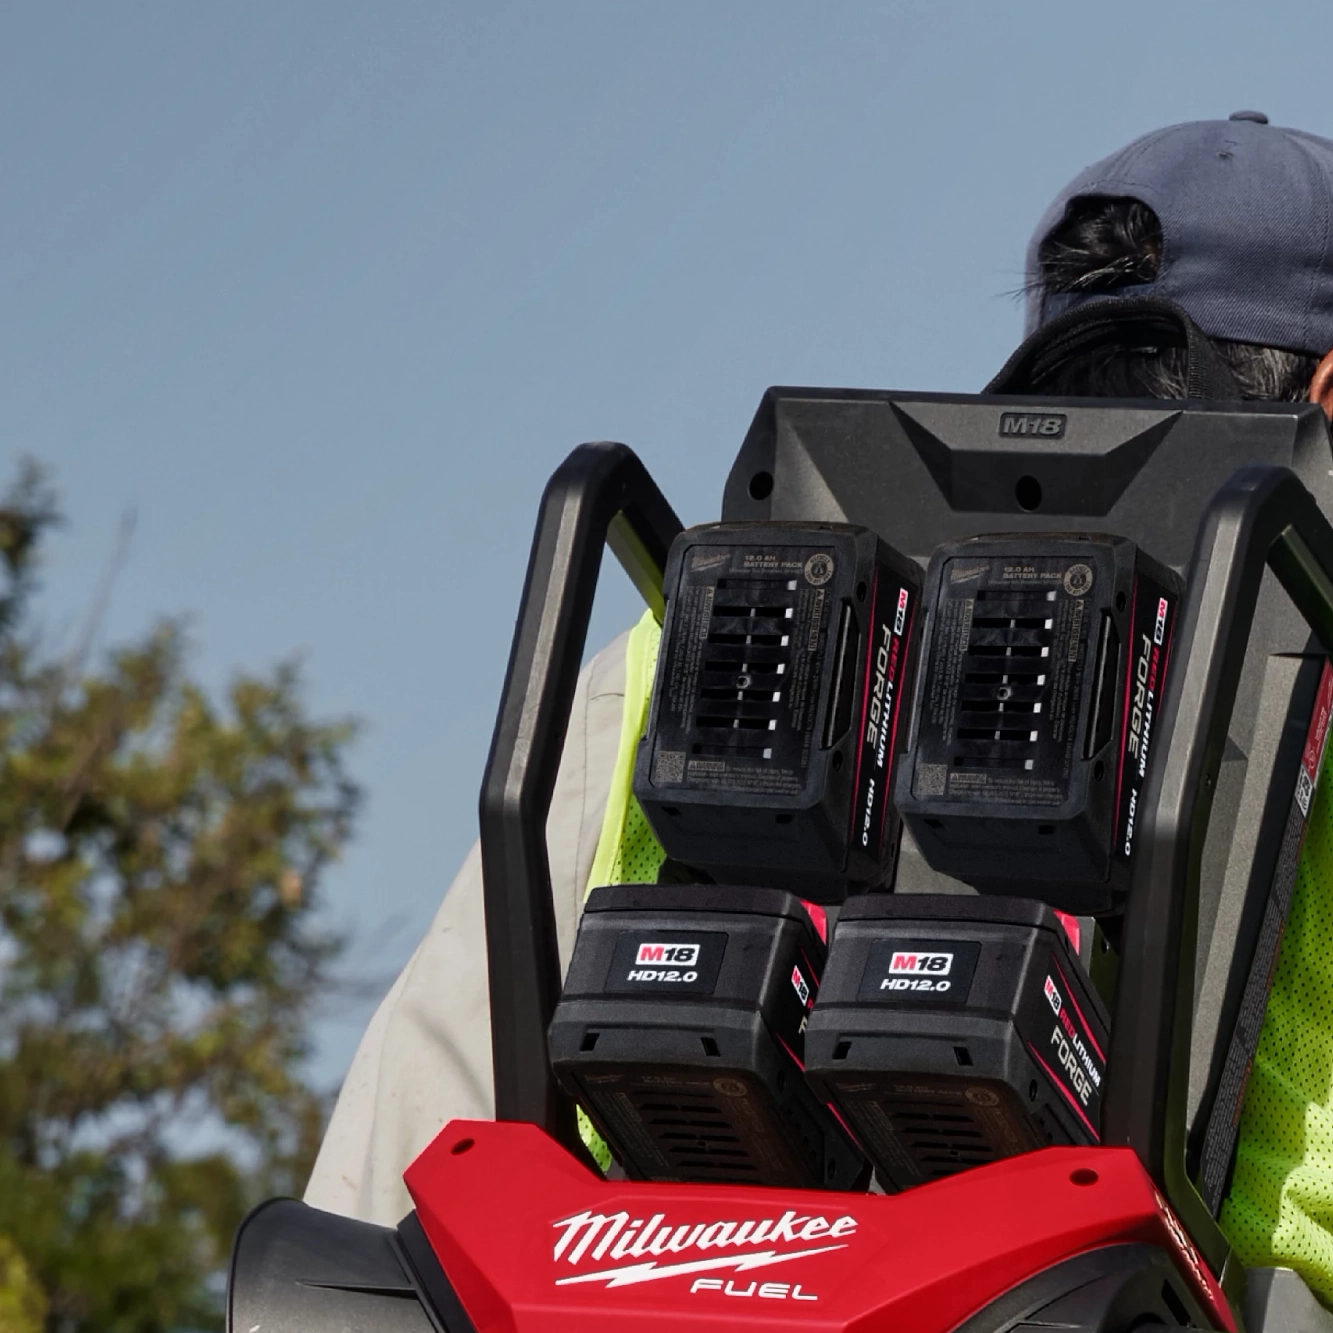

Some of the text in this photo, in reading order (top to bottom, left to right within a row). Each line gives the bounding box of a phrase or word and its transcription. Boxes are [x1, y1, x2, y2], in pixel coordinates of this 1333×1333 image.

[1003, 416, 1063, 436] M18
[781, 561, 804, 569] PACK
[866, 623, 893, 750] FORGE
[876, 591, 909, 768] M18 REDLITHIUM
[1127, 632, 1152, 760] FORGE
[1138, 601, 1168, 778] M18 REDLITHIUM
[861, 778, 876, 847] HD12.0
[1124, 788, 1138, 857] HD12.0
[627, 970, 698, 983] HD12.0
[640, 946, 696, 963] M18
[880, 978, 952, 992] HD12.0
[893, 955, 949, 972] M18
[1044, 979, 1102, 1088] M18 REDLITHIUM
[1050, 1025, 1093, 1107] FORGE
[552, 1210, 859, 1266] Milwaukee
[689, 1278, 819, 1302] FUEL
